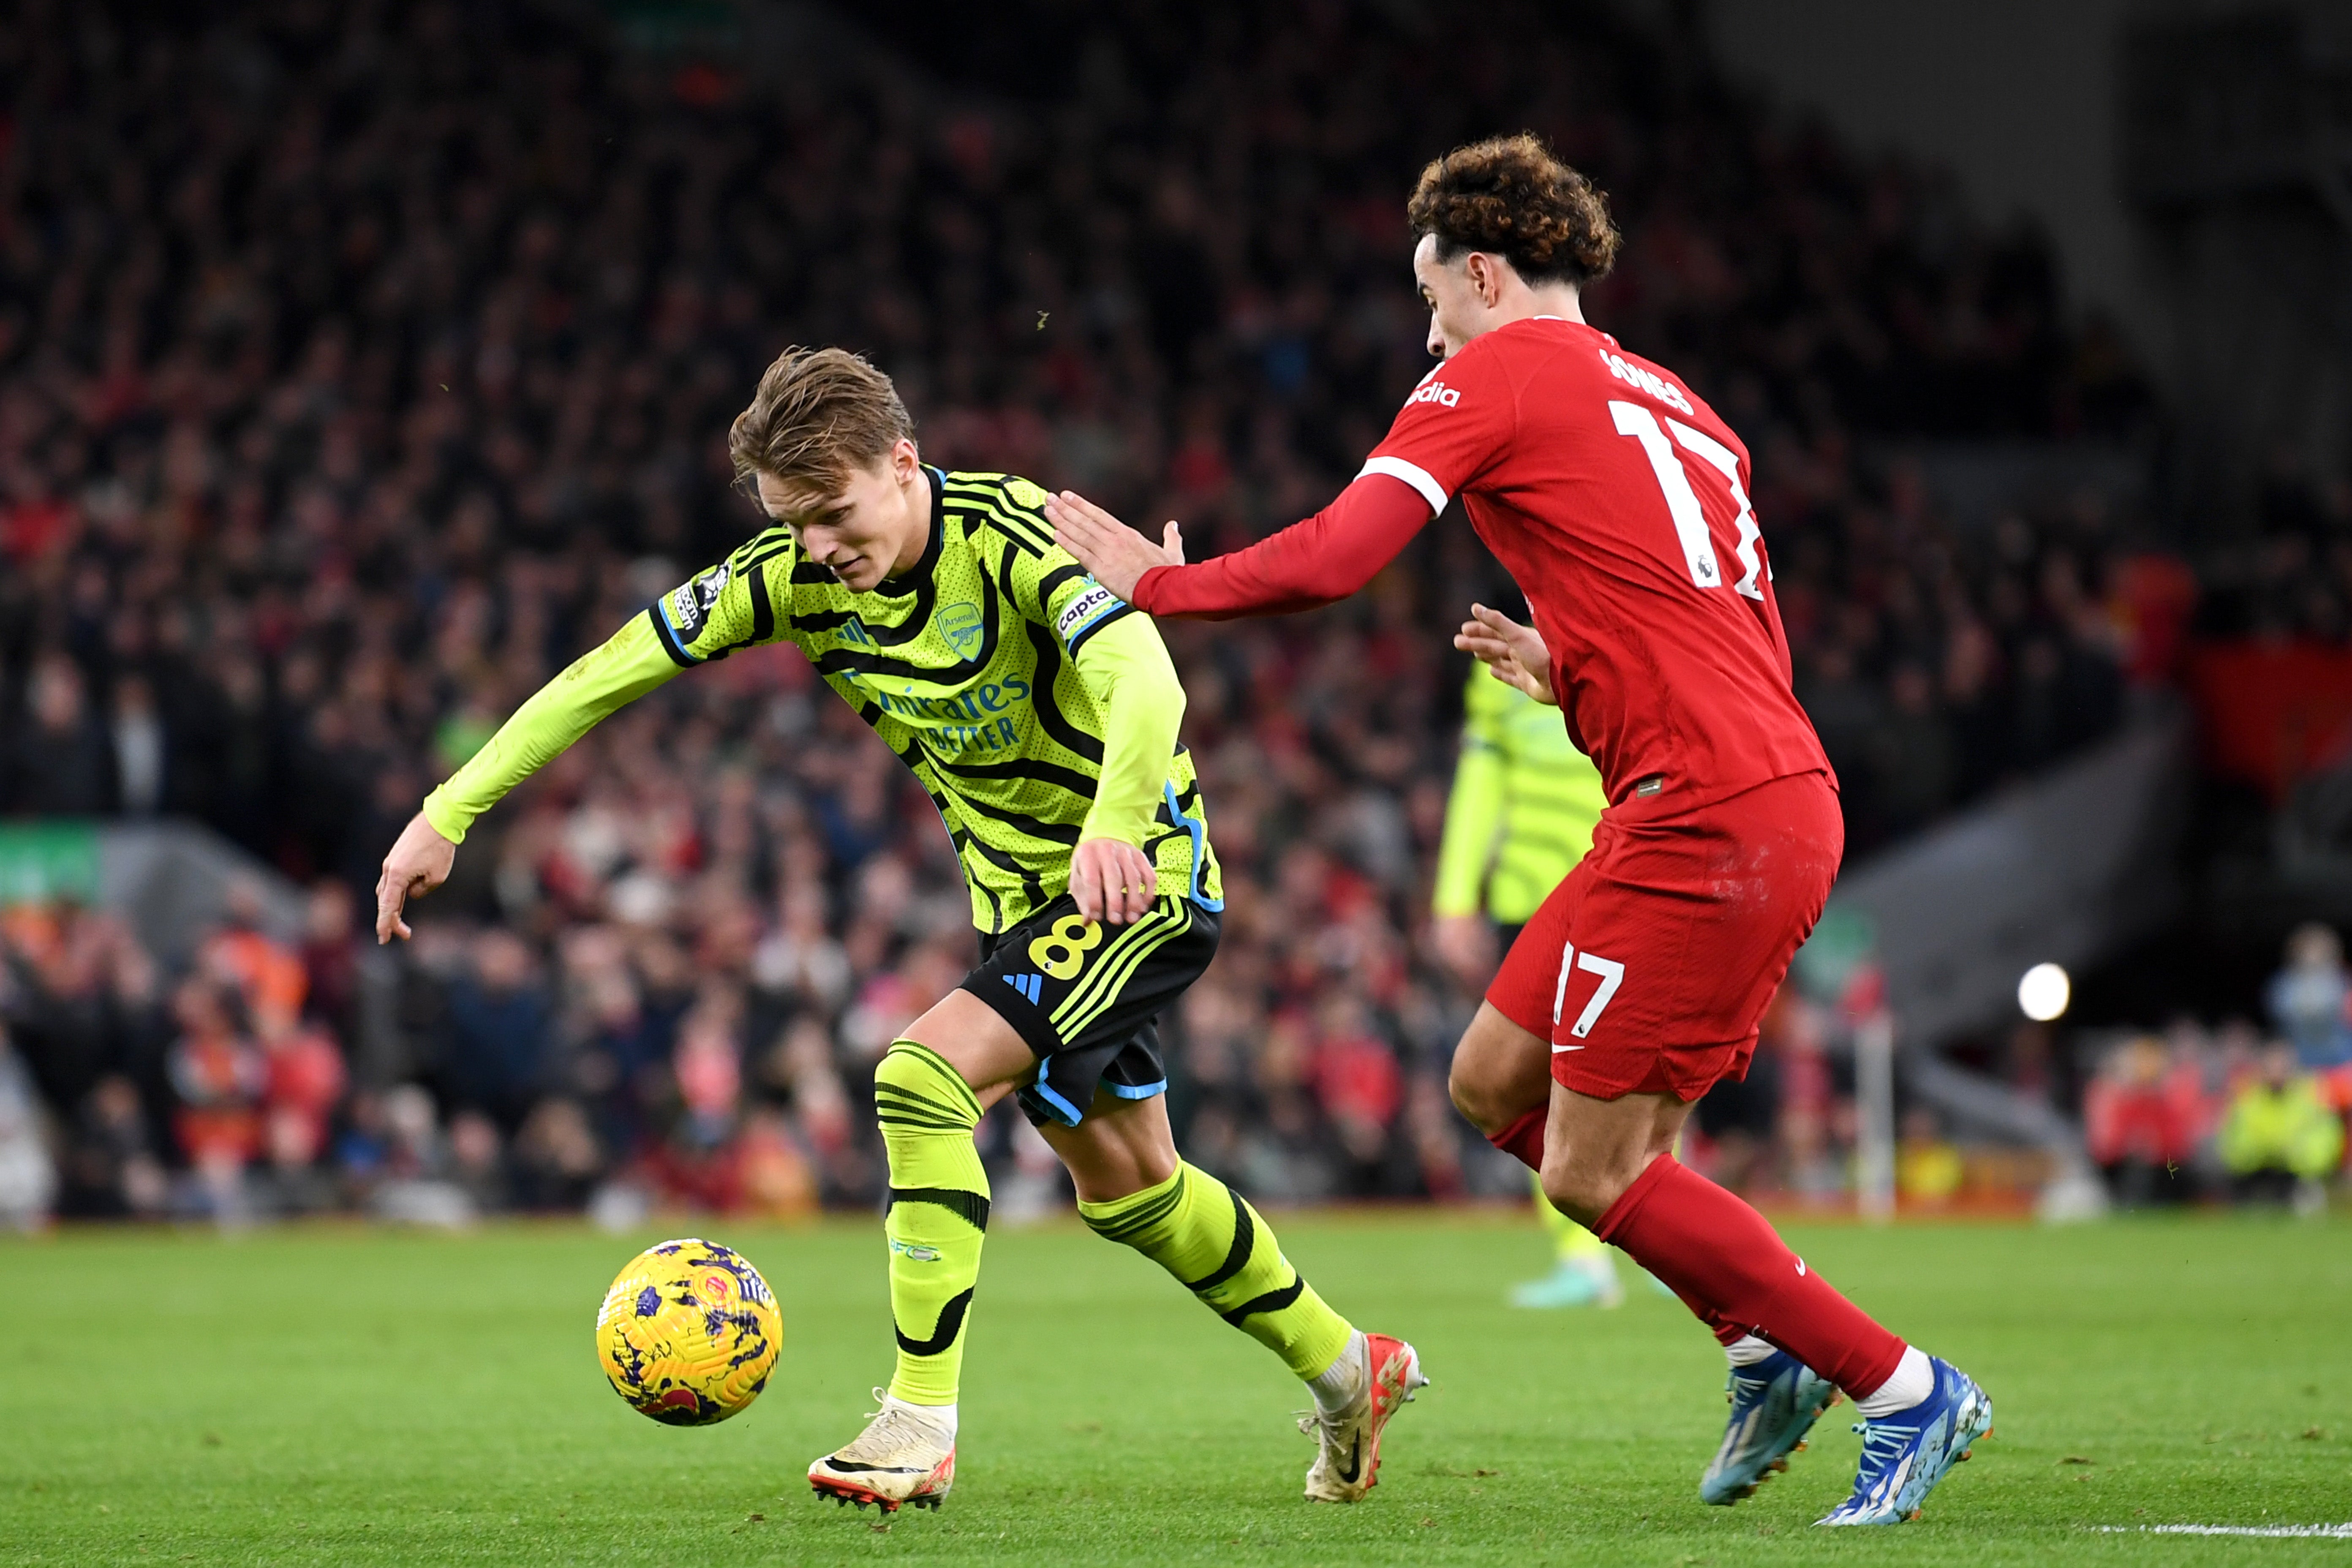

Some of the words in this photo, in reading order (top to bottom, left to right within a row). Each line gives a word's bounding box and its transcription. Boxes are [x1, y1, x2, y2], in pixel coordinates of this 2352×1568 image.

[1599, 348, 1694, 416] JONES
[1608, 400, 1764, 602] 17
[1028, 914, 1102, 980] 8
[1553, 940, 1625, 1039] 17
